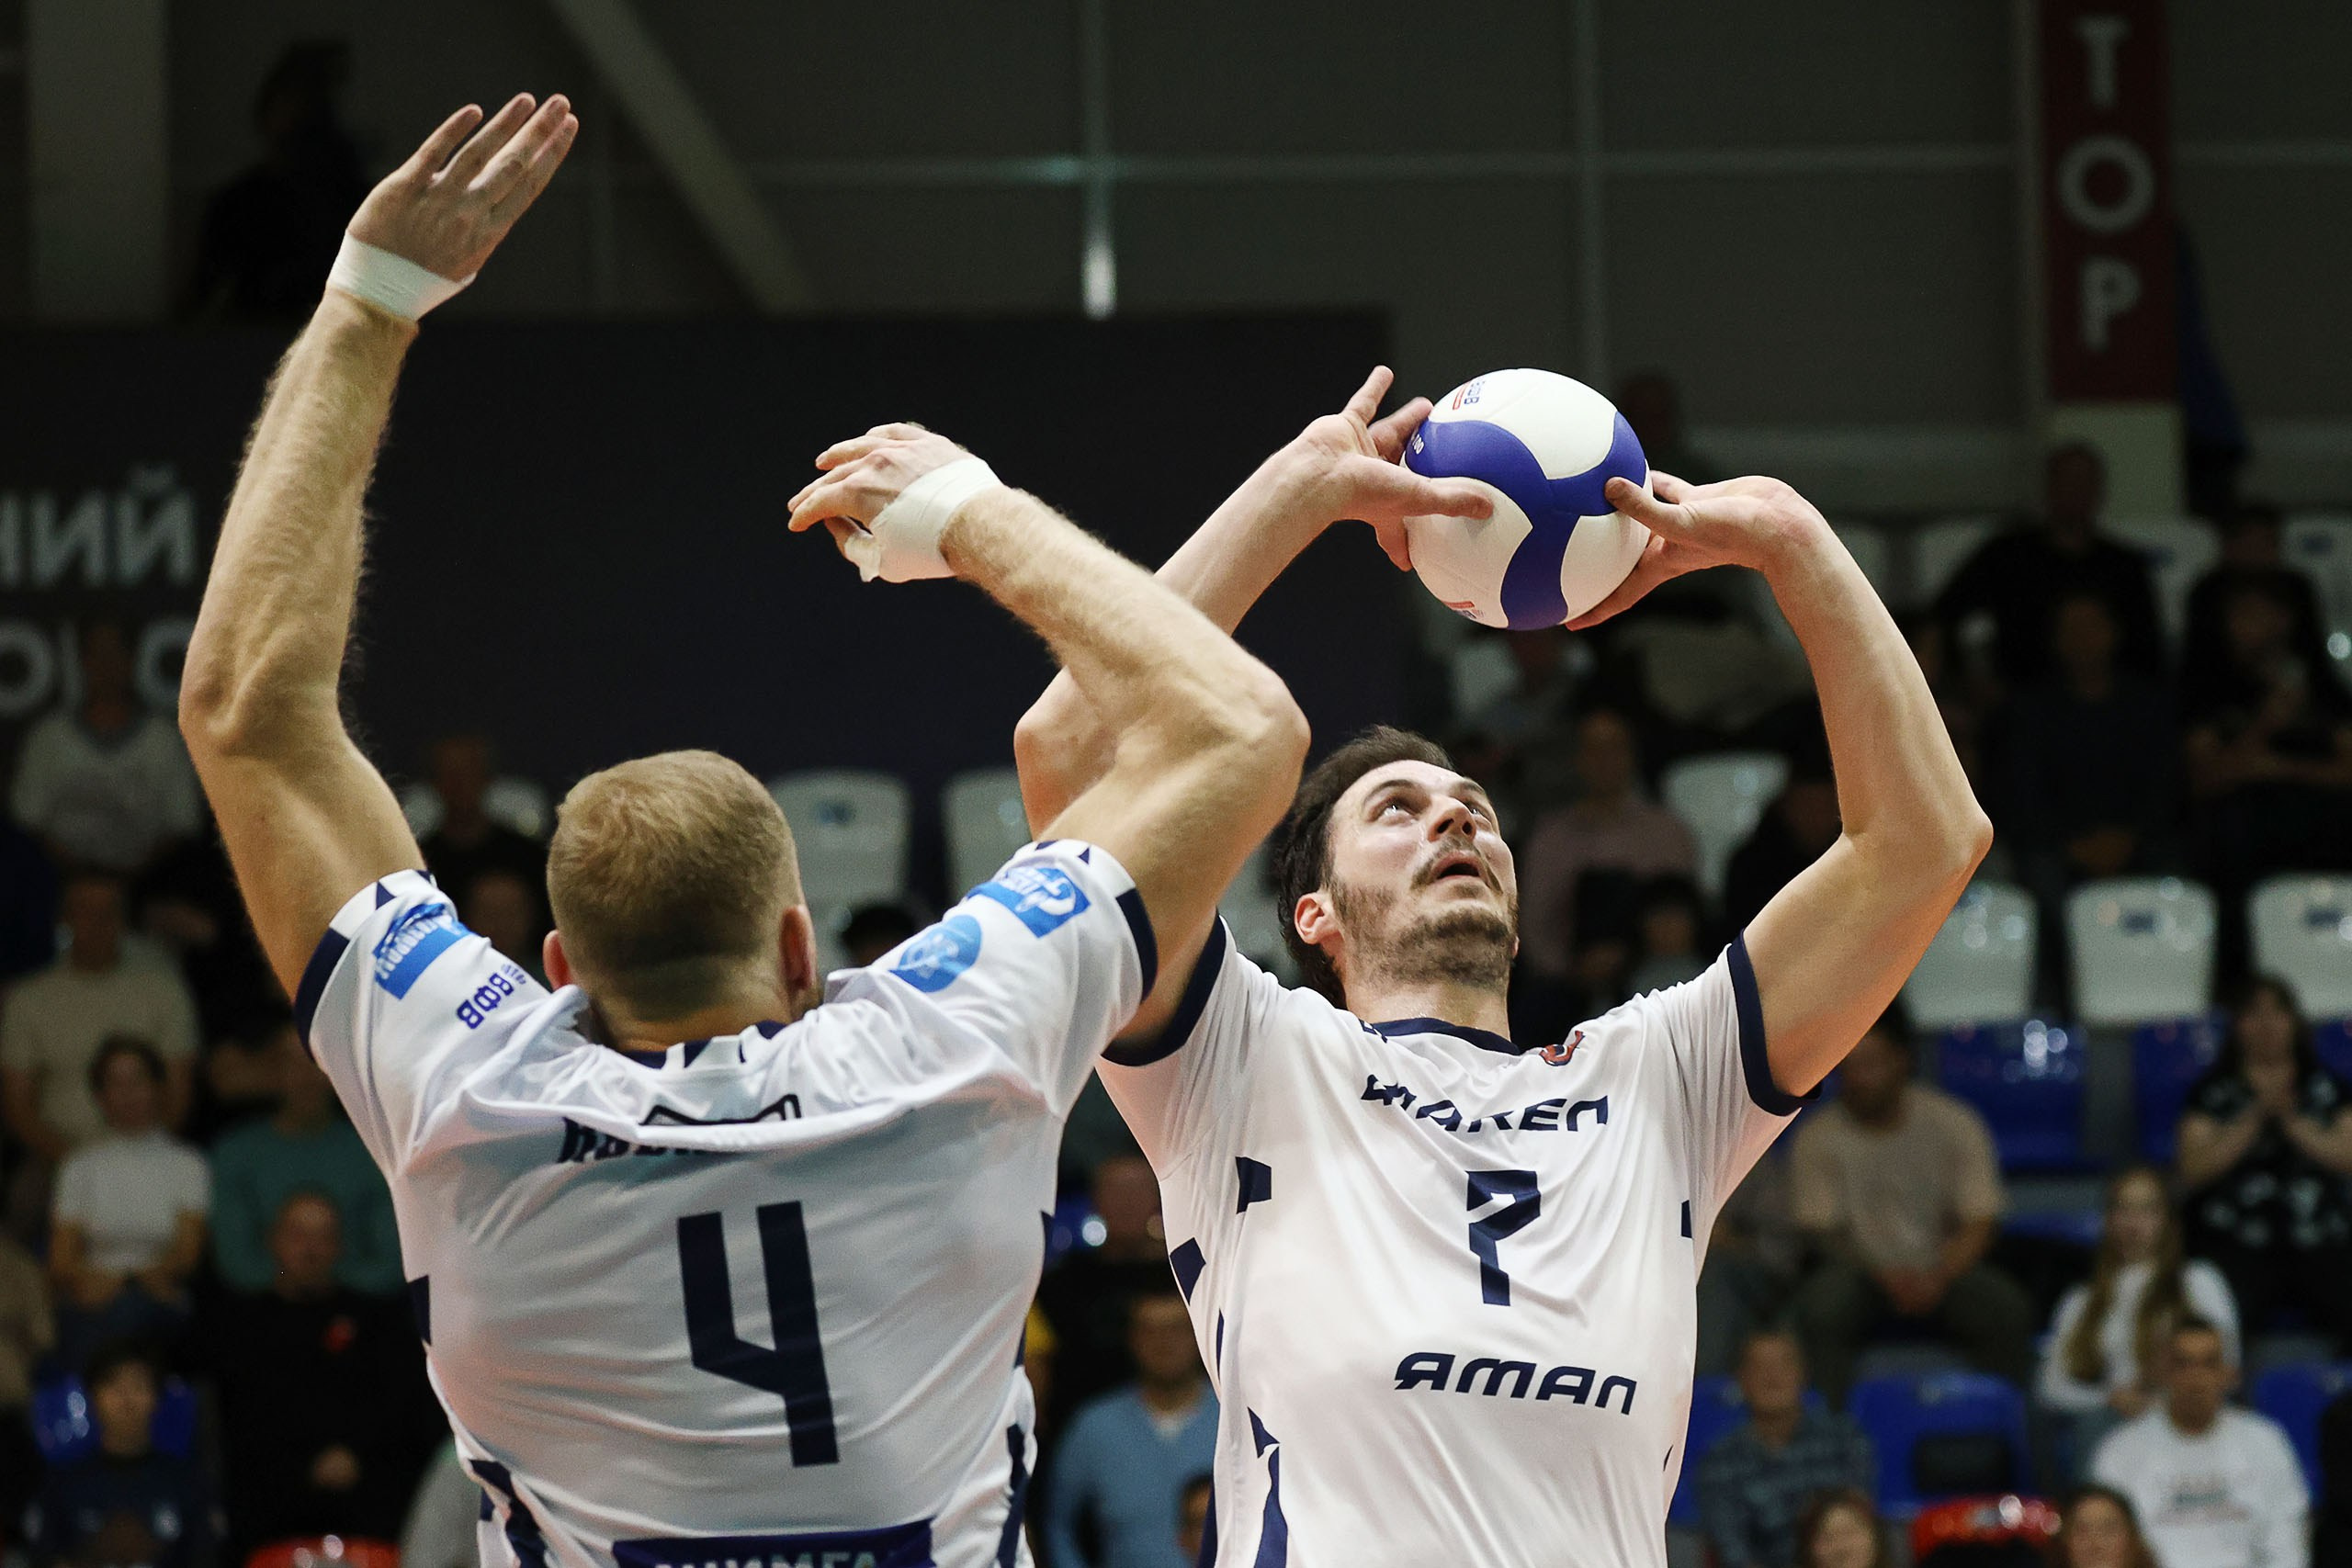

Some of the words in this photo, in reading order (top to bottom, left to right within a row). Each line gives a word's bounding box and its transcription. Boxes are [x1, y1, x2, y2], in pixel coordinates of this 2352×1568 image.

[0, 467, 196, 586] ИЙ
[677, 1201, 840, 1467] 4
[1395, 1351, 1638, 1416] ЯМАЛ
